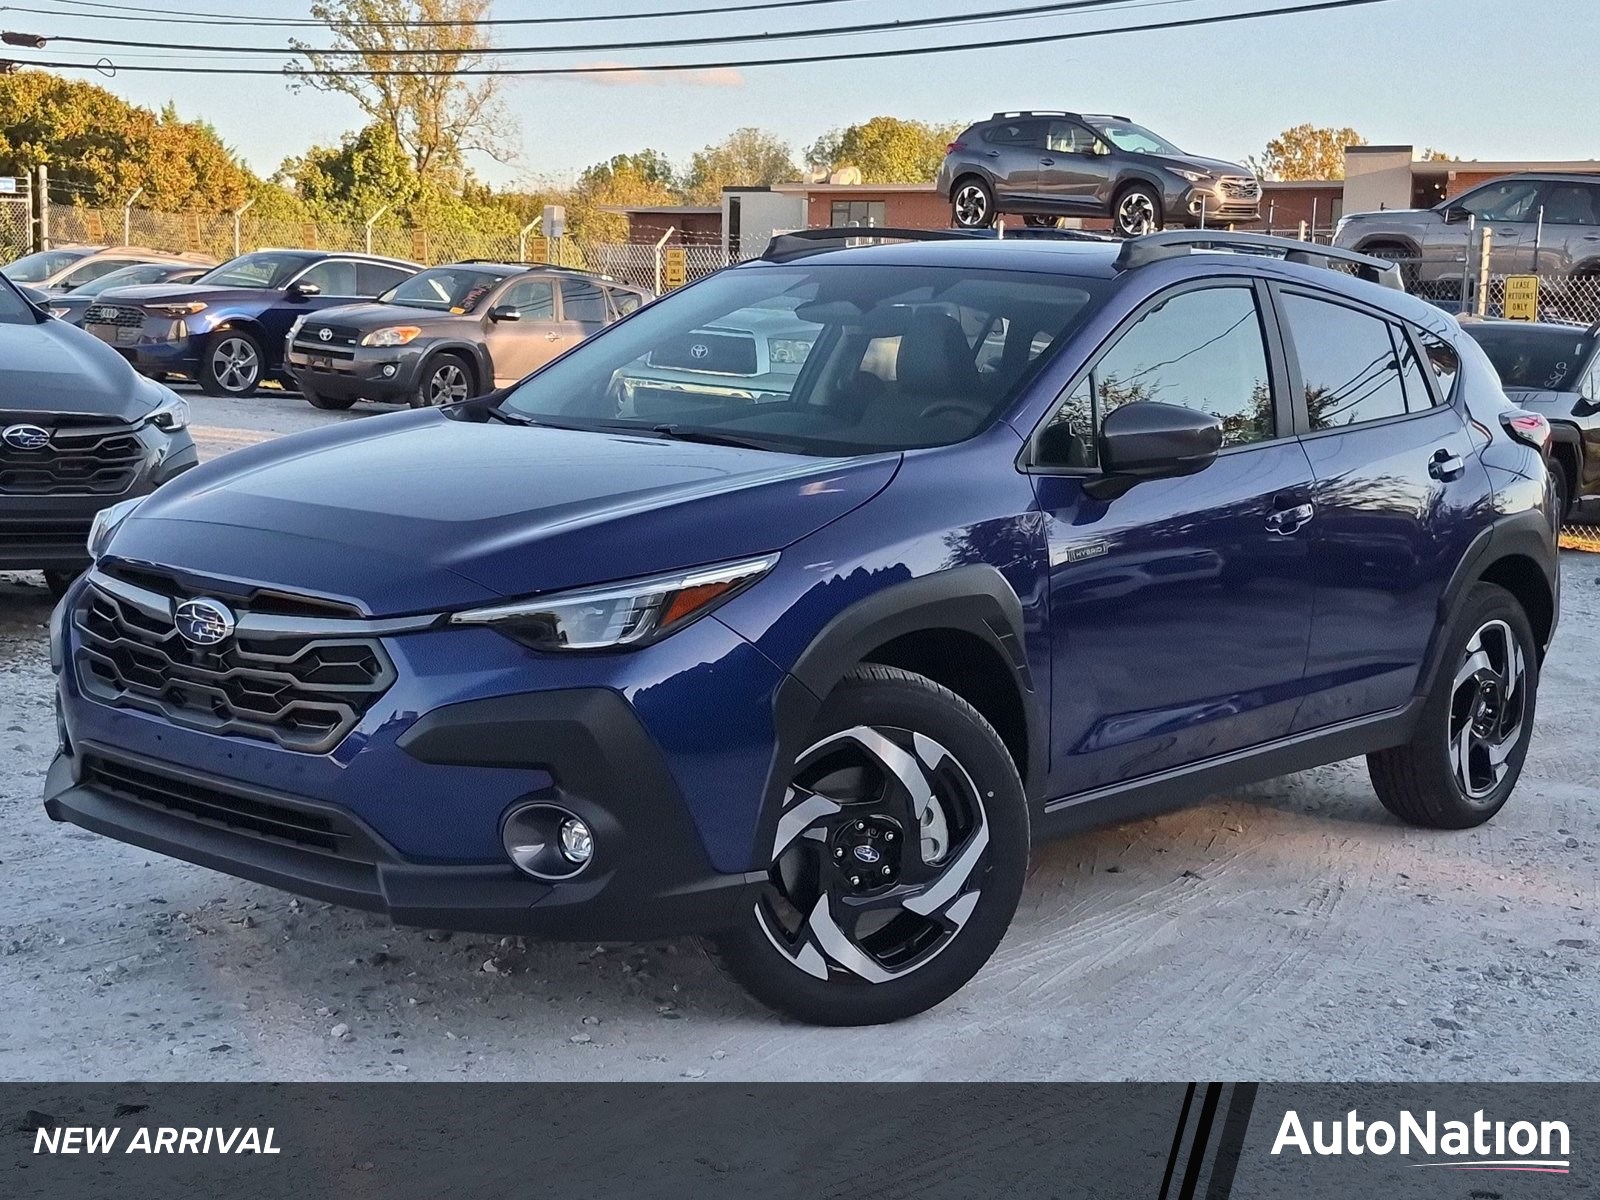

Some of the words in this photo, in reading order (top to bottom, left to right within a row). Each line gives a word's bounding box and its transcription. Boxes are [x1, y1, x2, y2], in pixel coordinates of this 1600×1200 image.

[1512, 281, 1530, 289] LEASE
[1508, 292, 1534, 300] RETURNS
[1512, 303, 1527, 311] ONLY
